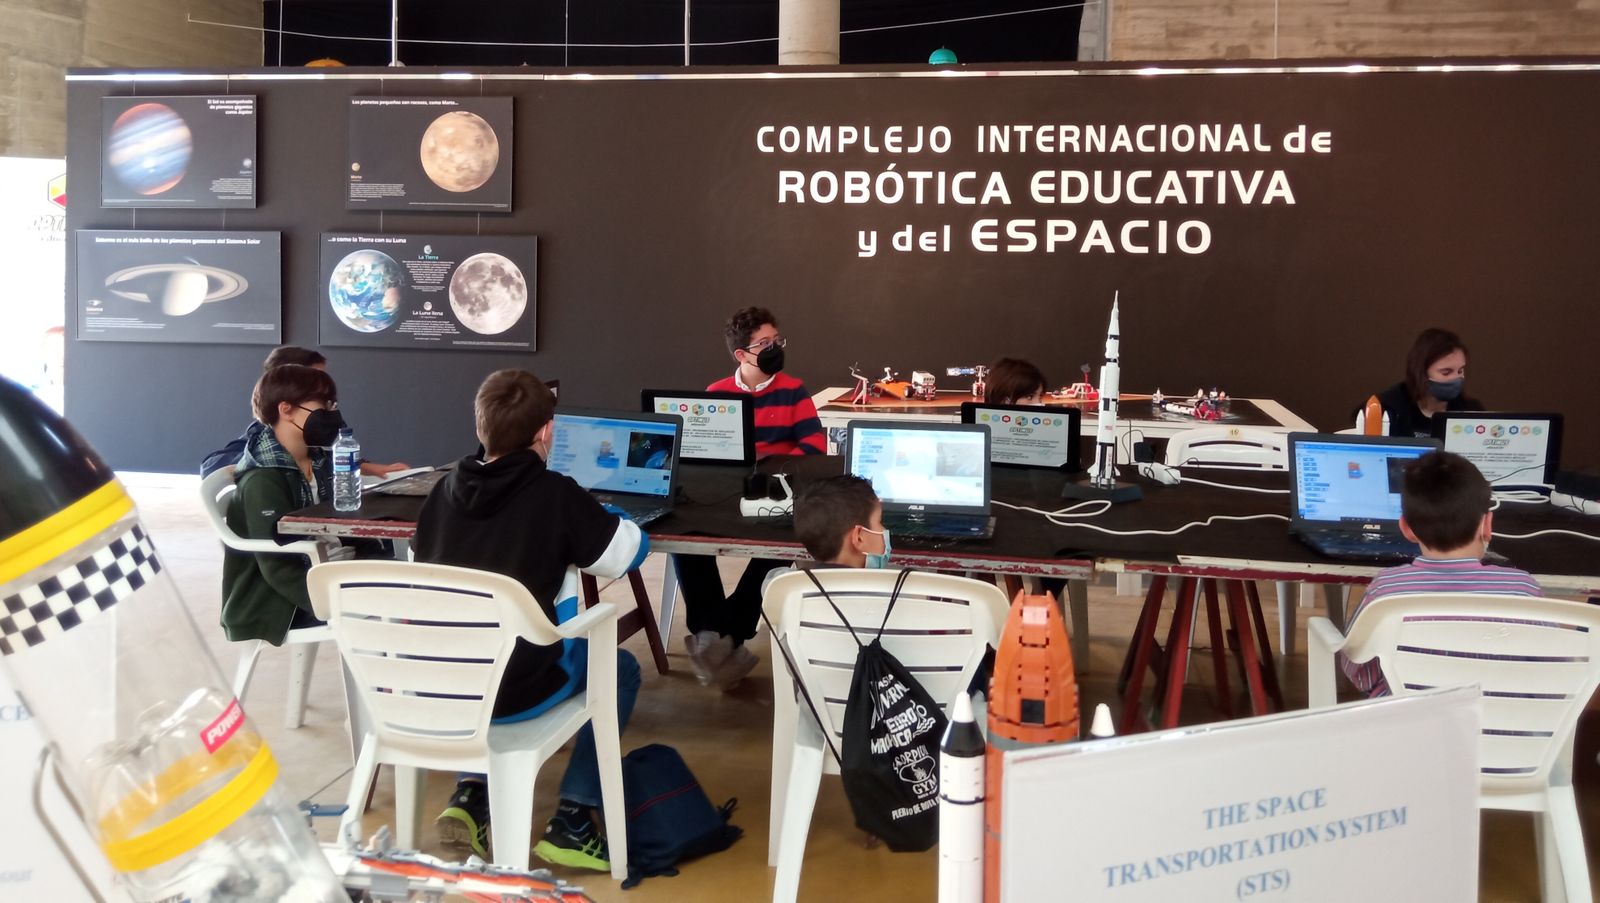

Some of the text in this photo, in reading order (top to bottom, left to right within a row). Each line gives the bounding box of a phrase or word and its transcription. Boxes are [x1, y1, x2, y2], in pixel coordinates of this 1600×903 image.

[757, 124, 1331, 153] COMPLEJO INTERNACIONAL de
[779, 163, 1296, 205] ROBÓTICA EDUCATIVA
[858, 219, 1211, 257] y del ESPACIO
[1202, 788, 1327, 830] THE SPACE
[1102, 806, 1409, 888] TRANSPORTATION SYSTEM
[1236, 868, 1291, 900] (STS)
